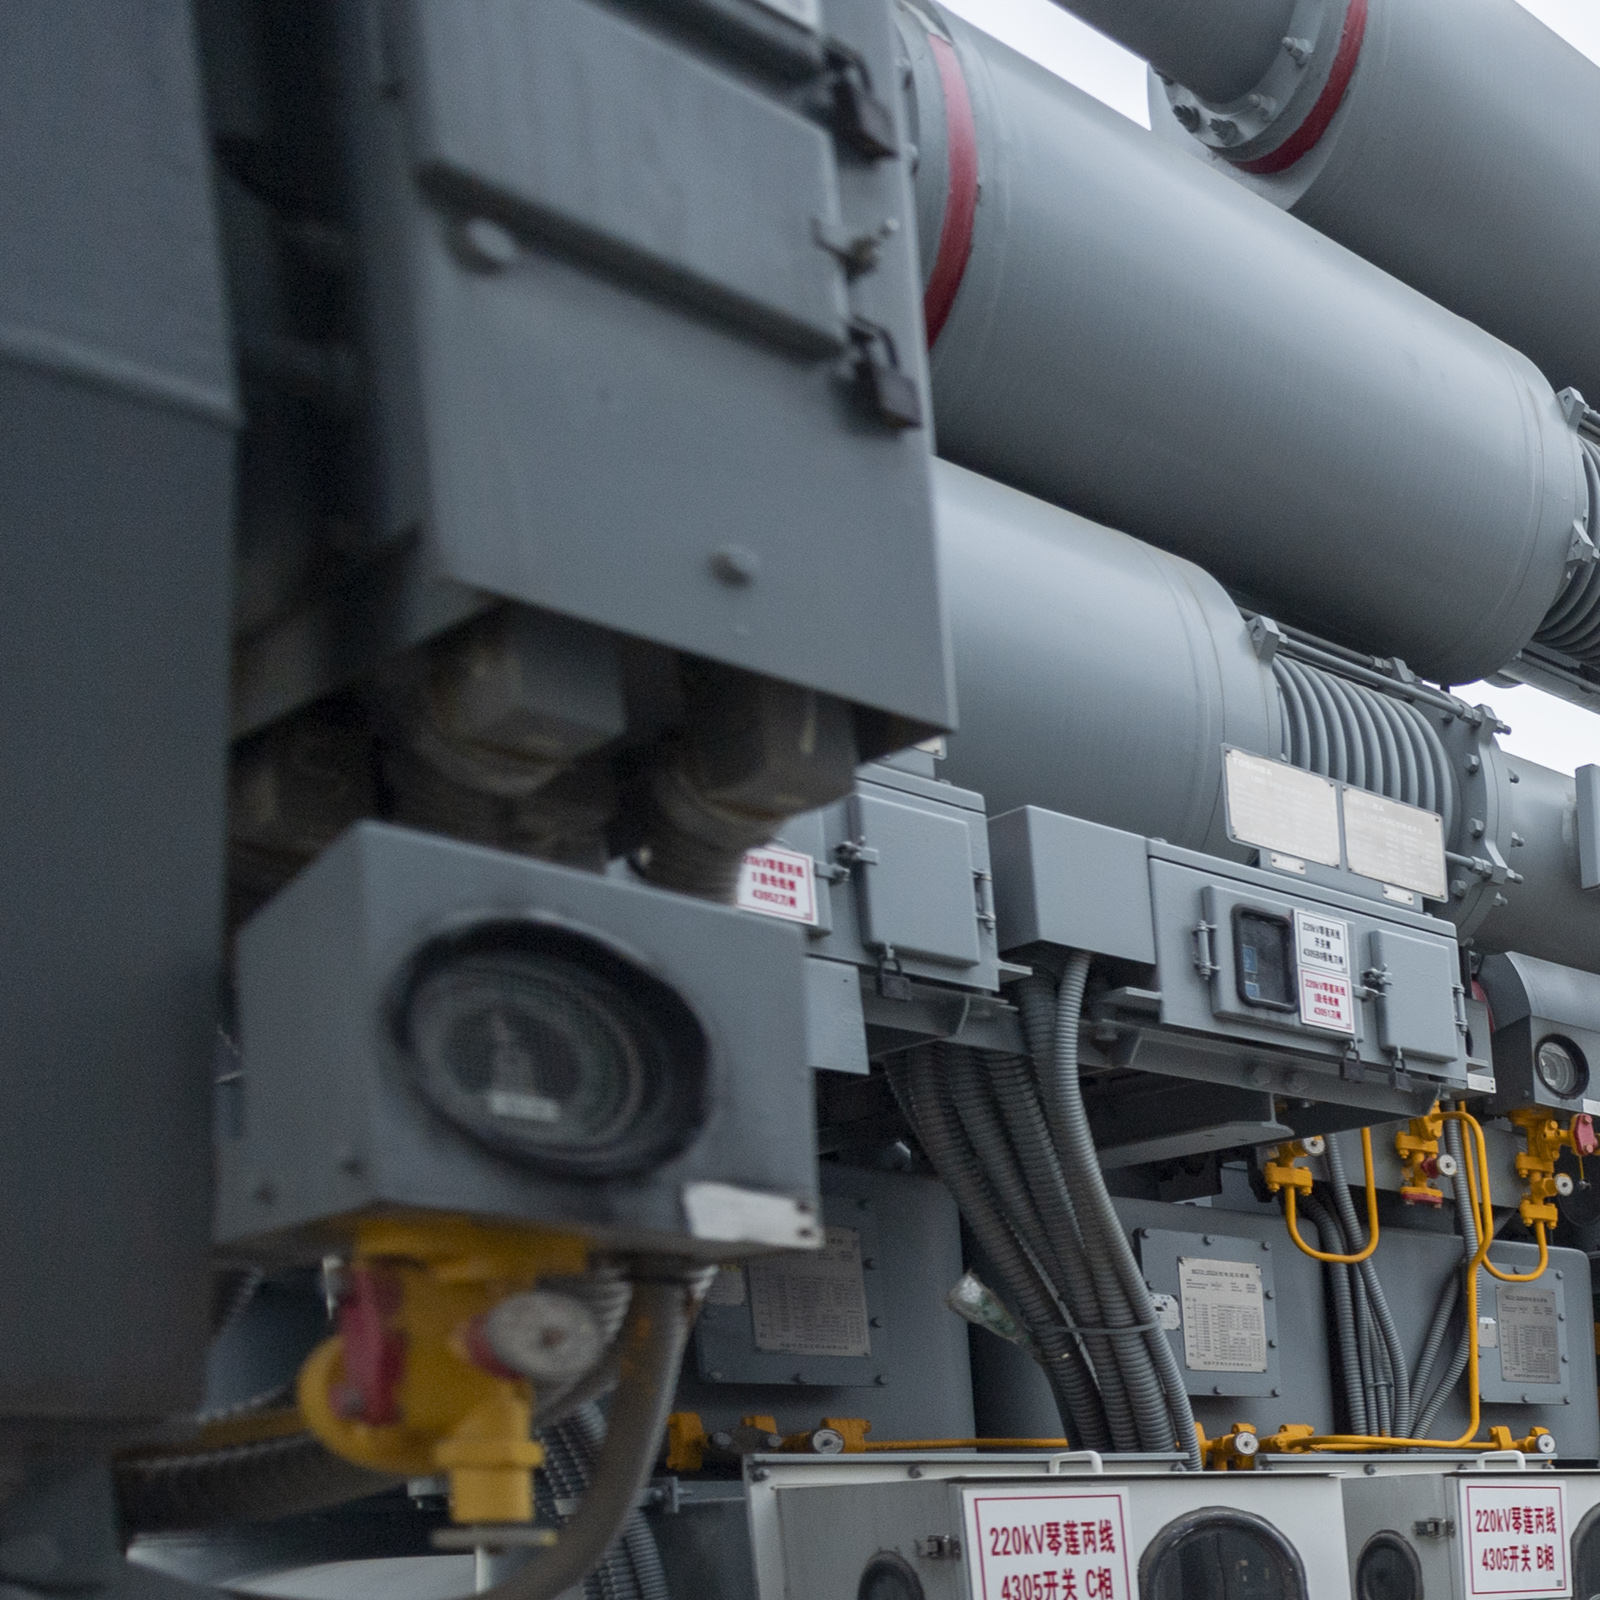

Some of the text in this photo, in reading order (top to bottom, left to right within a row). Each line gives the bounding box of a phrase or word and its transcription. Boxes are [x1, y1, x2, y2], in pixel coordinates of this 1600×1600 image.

[1475, 1506, 1557, 1535] 220kV琴莲丙线
[989, 1519, 1116, 1557] 220kV琴莲丙线
[1481, 1543, 1555, 1573] 4305开关 B相
[1085, 1566, 1114, 1600] C相
